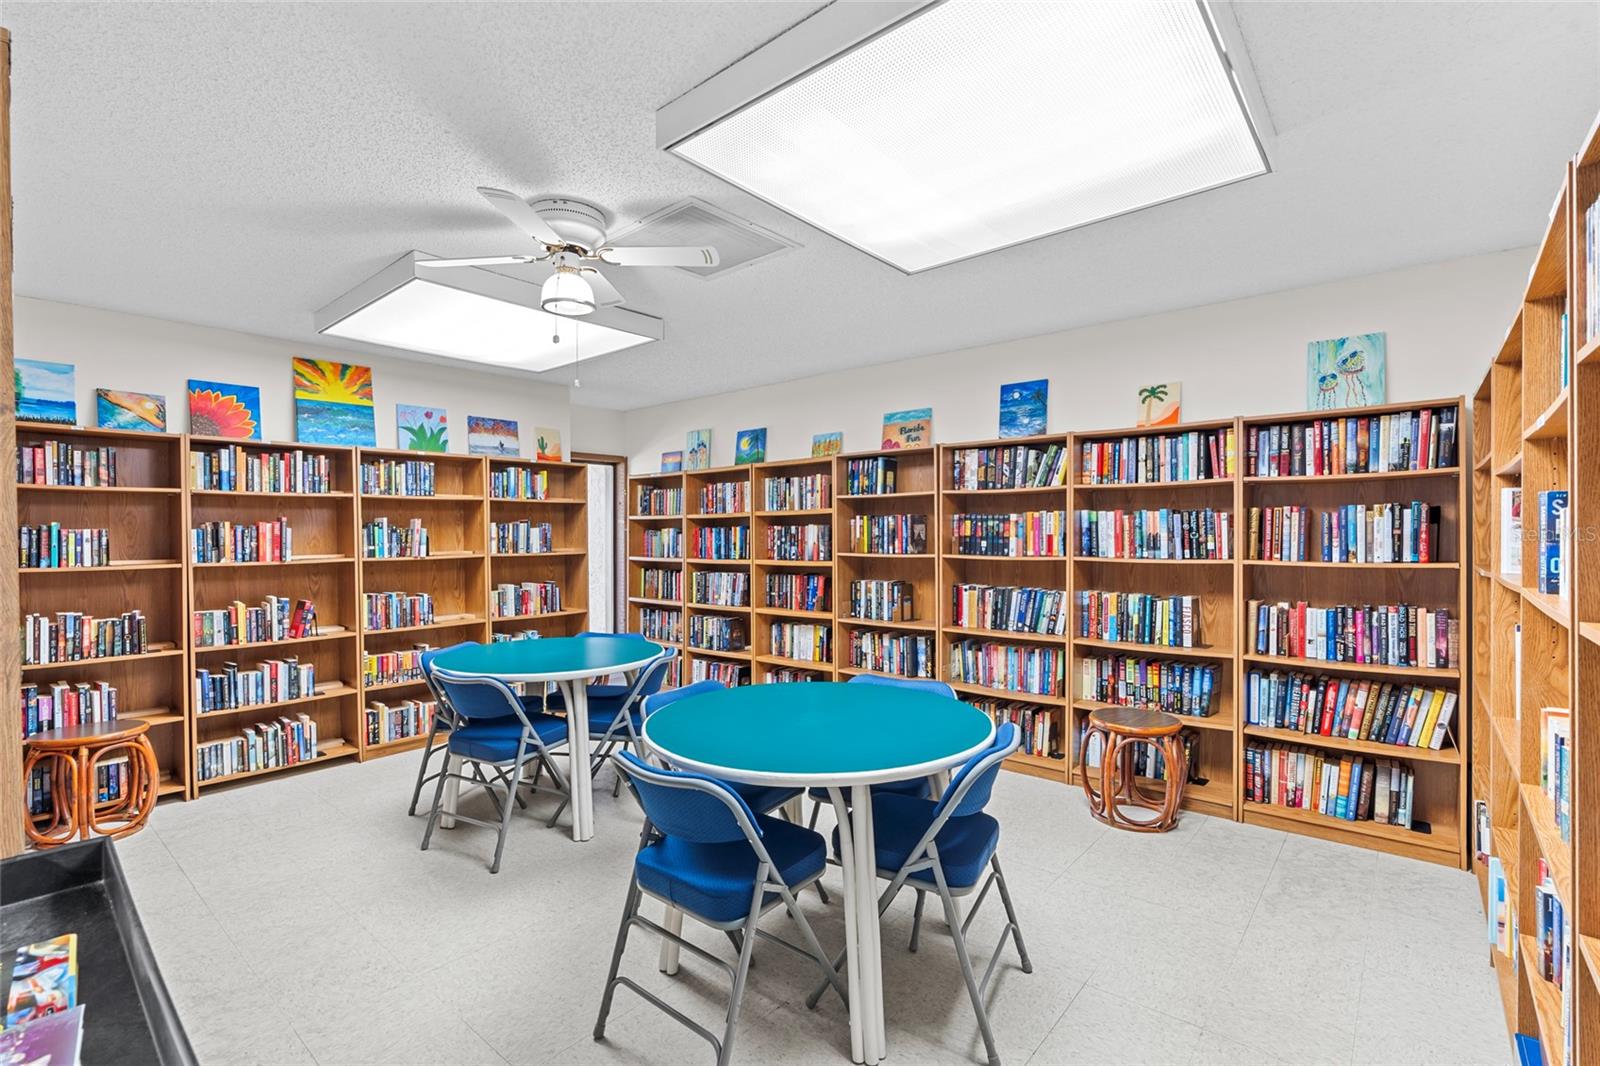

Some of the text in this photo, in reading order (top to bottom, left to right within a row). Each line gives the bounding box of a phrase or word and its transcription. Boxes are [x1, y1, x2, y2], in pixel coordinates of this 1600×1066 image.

[900, 423, 925, 435] Florida
[906, 435, 921, 443] Fun
[1183, 606, 1191, 634] FIASCO
